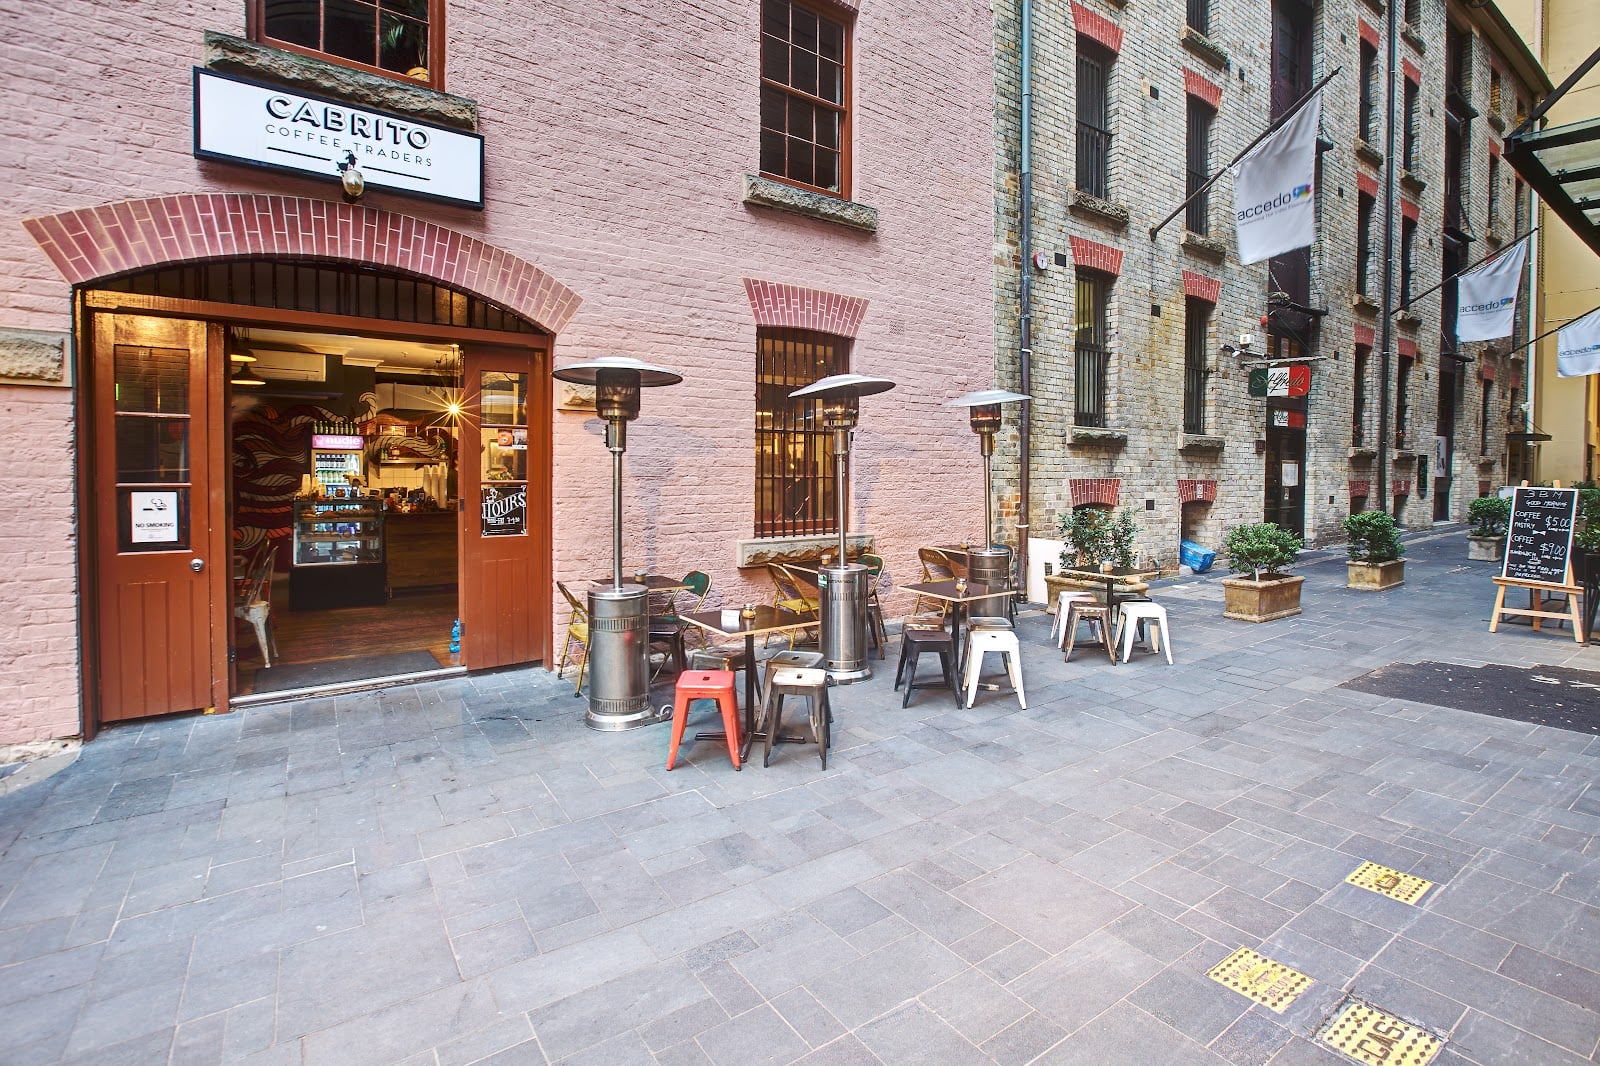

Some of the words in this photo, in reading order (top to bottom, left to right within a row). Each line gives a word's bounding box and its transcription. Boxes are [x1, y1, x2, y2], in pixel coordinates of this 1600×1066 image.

[266, 95, 431, 149] CABRITO
[265, 124, 340, 148] COFFEE
[353, 142, 432, 167] TRADERS
[1237, 192, 1291, 221] accedo
[1460, 301, 1499, 312] accedo
[481, 491, 526, 519] HOURS
[1515, 510, 1541, 520] COFFEE
[1511, 534, 1534, 545] COFFEE
[1357, 1021, 1405, 1061] GAS
